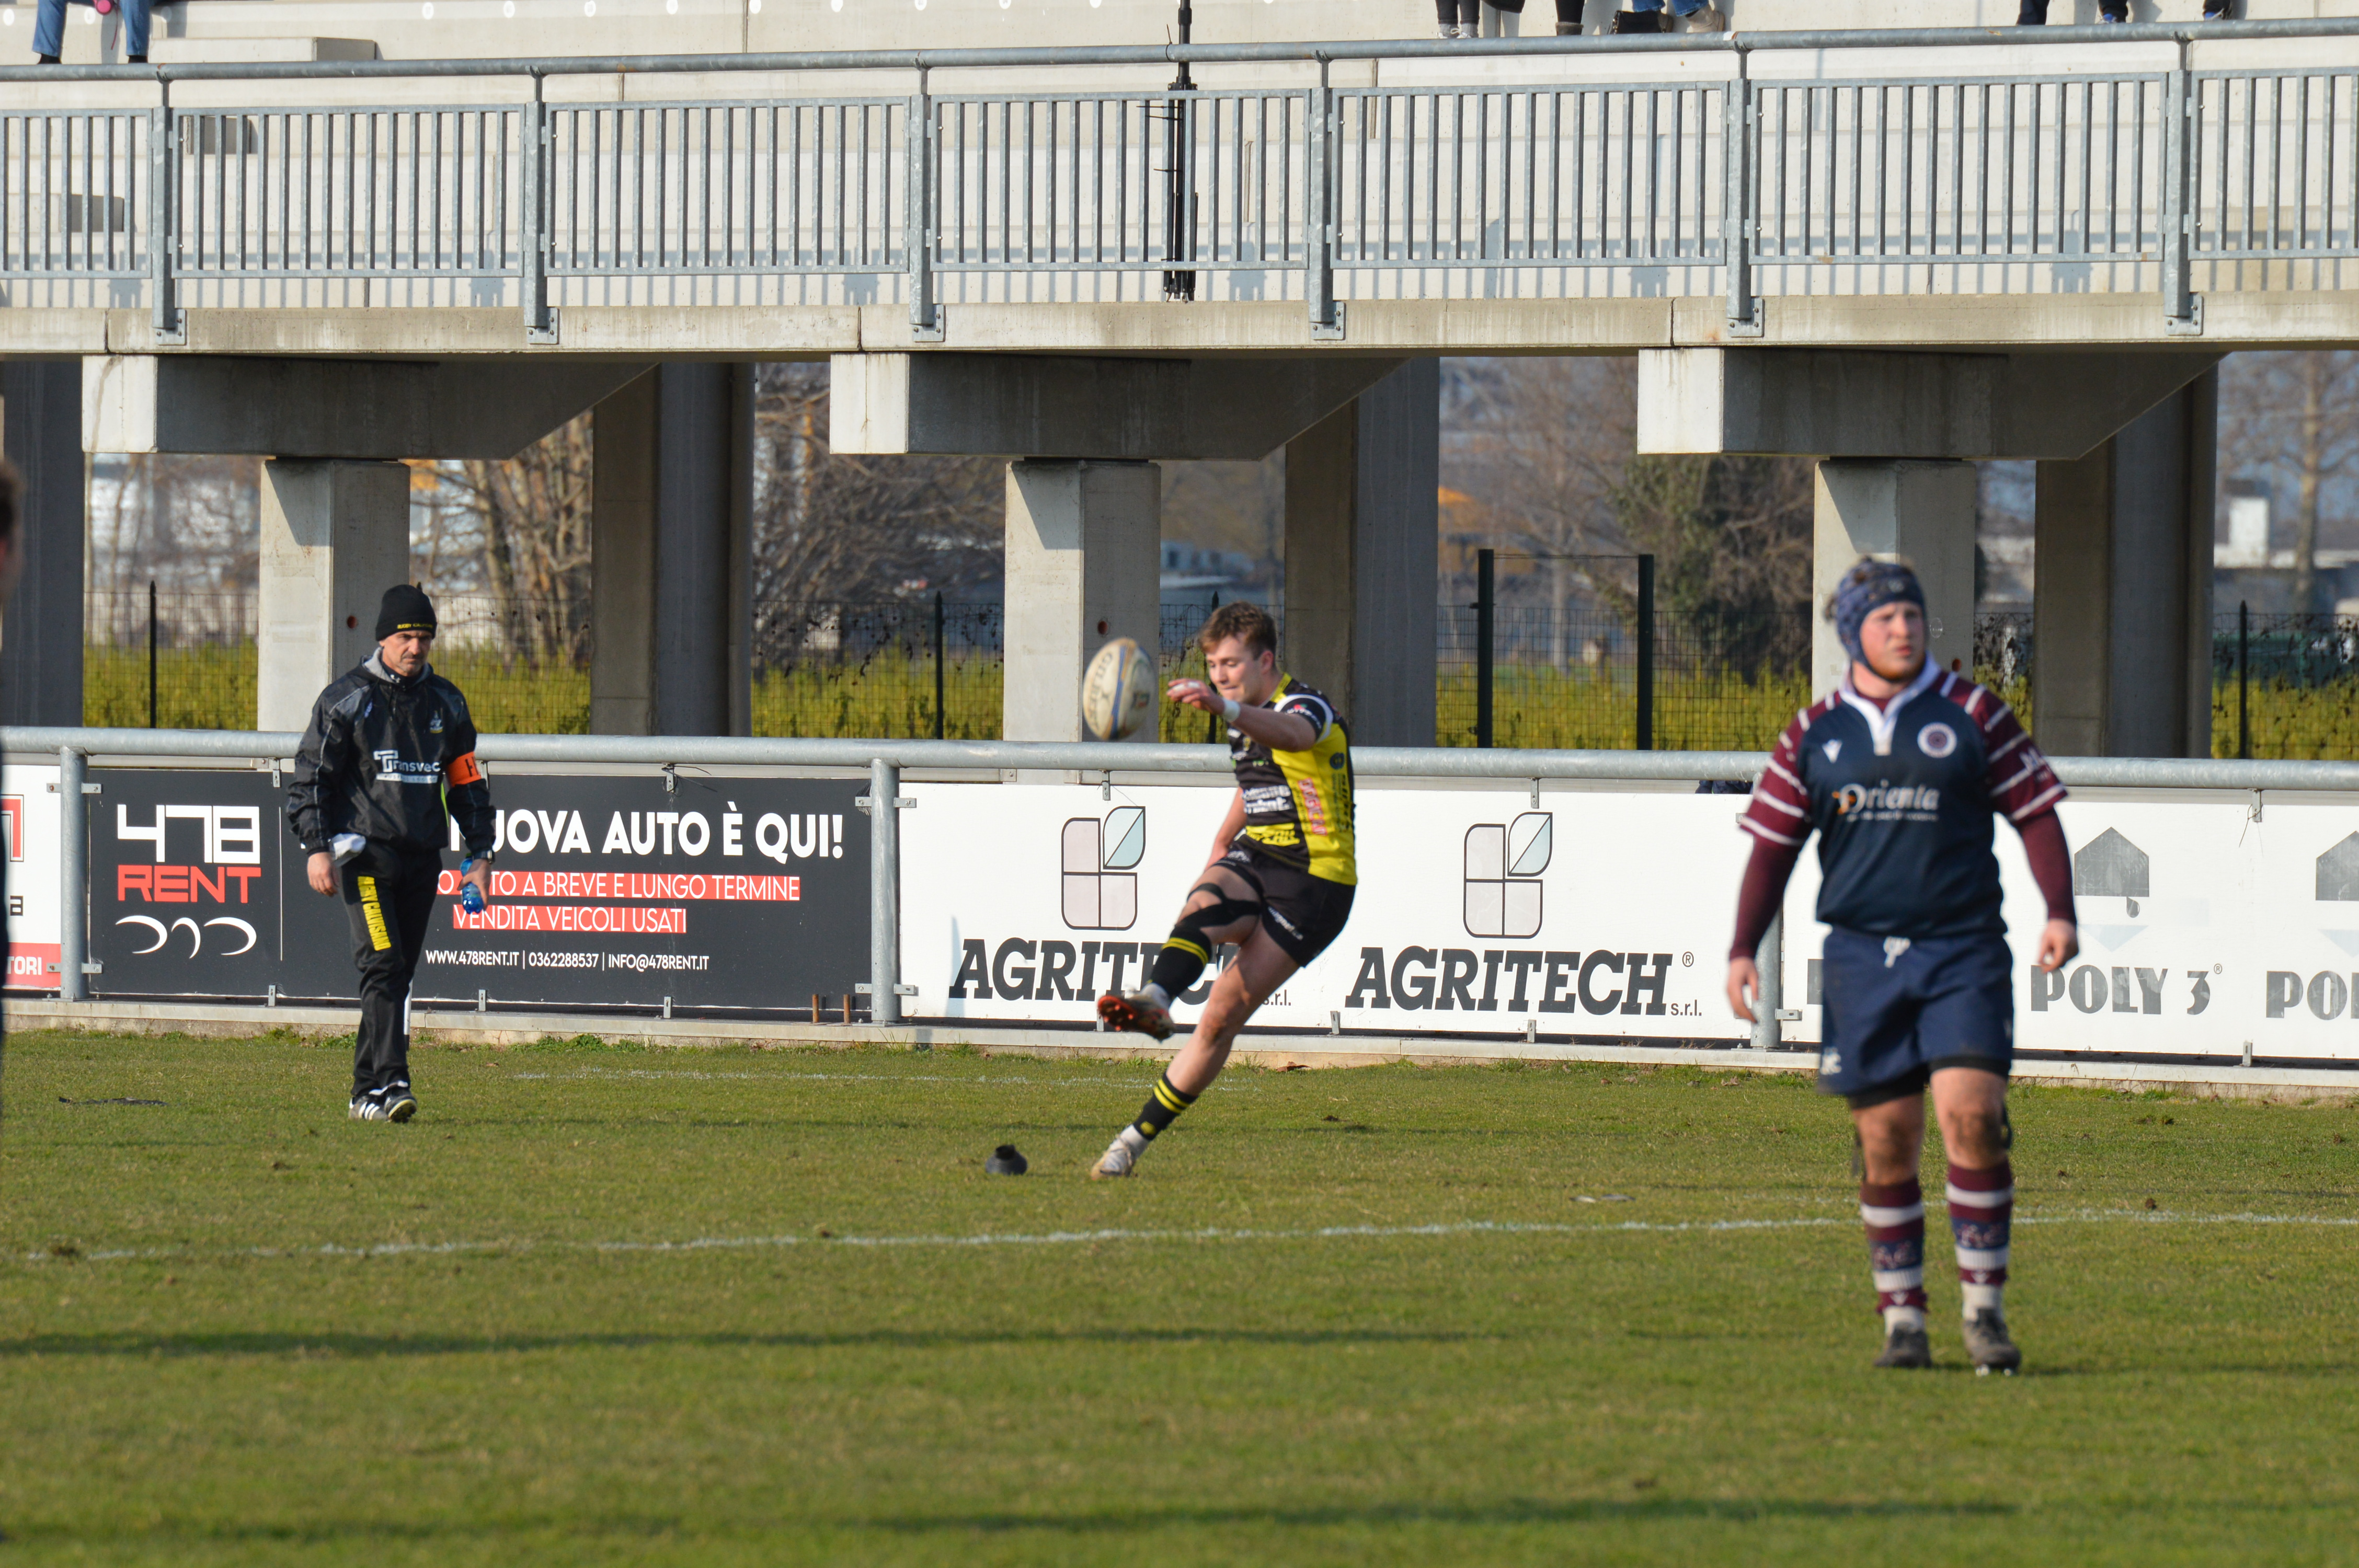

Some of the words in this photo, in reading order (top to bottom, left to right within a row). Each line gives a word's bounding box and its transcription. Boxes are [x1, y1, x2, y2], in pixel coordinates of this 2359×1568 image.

[1838, 779, 1940, 813] Orienta
[118, 804, 260, 864] 478
[602, 811, 711, 856] AUTO
[723, 801, 743, 856] È
[755, 813, 843, 864] QUI!
[118, 864, 261, 903] RENT
[358, 876, 378, 902] GBY
[522, 872, 537, 896] A
[544, 872, 607, 897] BREVE
[614, 873, 625, 897] E
[632, 873, 706, 899] LUNGO
[712, 875, 800, 901] TERMINE
[363, 902, 392, 951] CALVISANO
[453, 905, 541, 930] VENDITA
[546, 906, 625, 931] VEICOLI
[632, 908, 686, 933] USATI
[426, 950, 520, 966] WWW.478RENT.IT
[529, 952, 599, 967] 0362288537
[609, 954, 709, 972] INFO@478RENT.IT
[948, 937, 1241, 1006] AGRIT
[1345, 946, 1673, 1016] AGRITECH
[1671, 999, 1702, 1016] s.r.l.
[2031, 964, 2168, 1015] POLY
[2186, 971, 2211, 1016] 3
